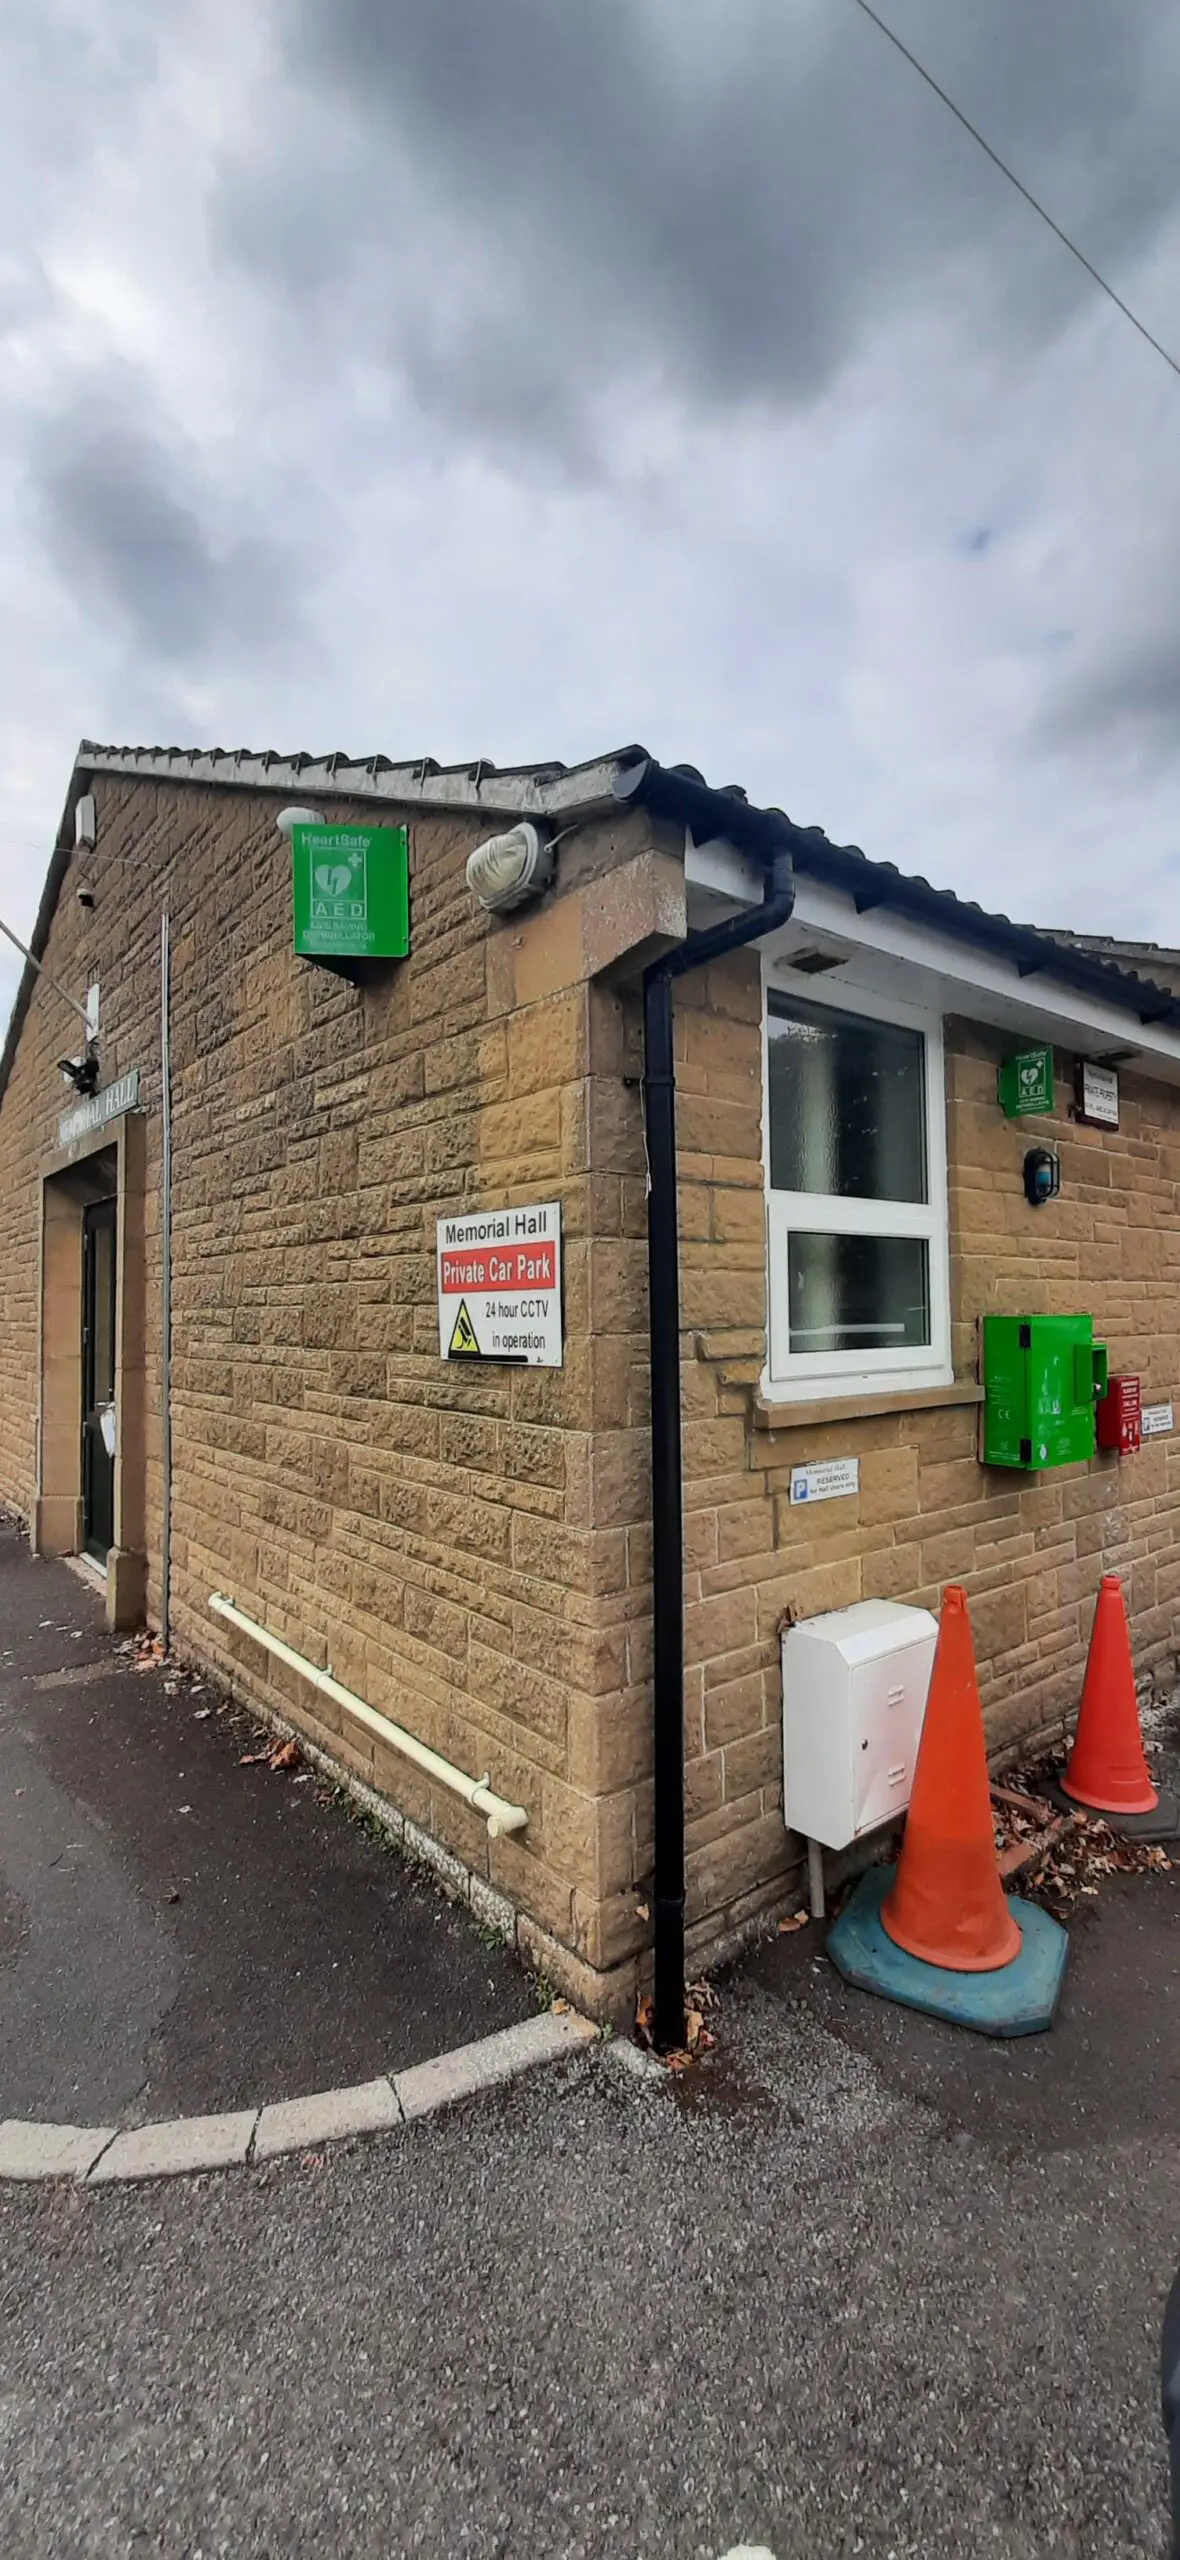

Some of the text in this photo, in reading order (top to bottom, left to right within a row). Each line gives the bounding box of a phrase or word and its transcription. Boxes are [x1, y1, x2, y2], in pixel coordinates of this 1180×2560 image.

[301, 832, 371, 848] HeartSafe
[105, 1077, 135, 1116] HALL
[445, 1210, 547, 1245] Memorial Hall
[443, 1251, 551, 1285] Private Car Park
[485, 1299, 549, 1318] 24 hour CCTV
[492, 1331, 546, 1352] in operation
